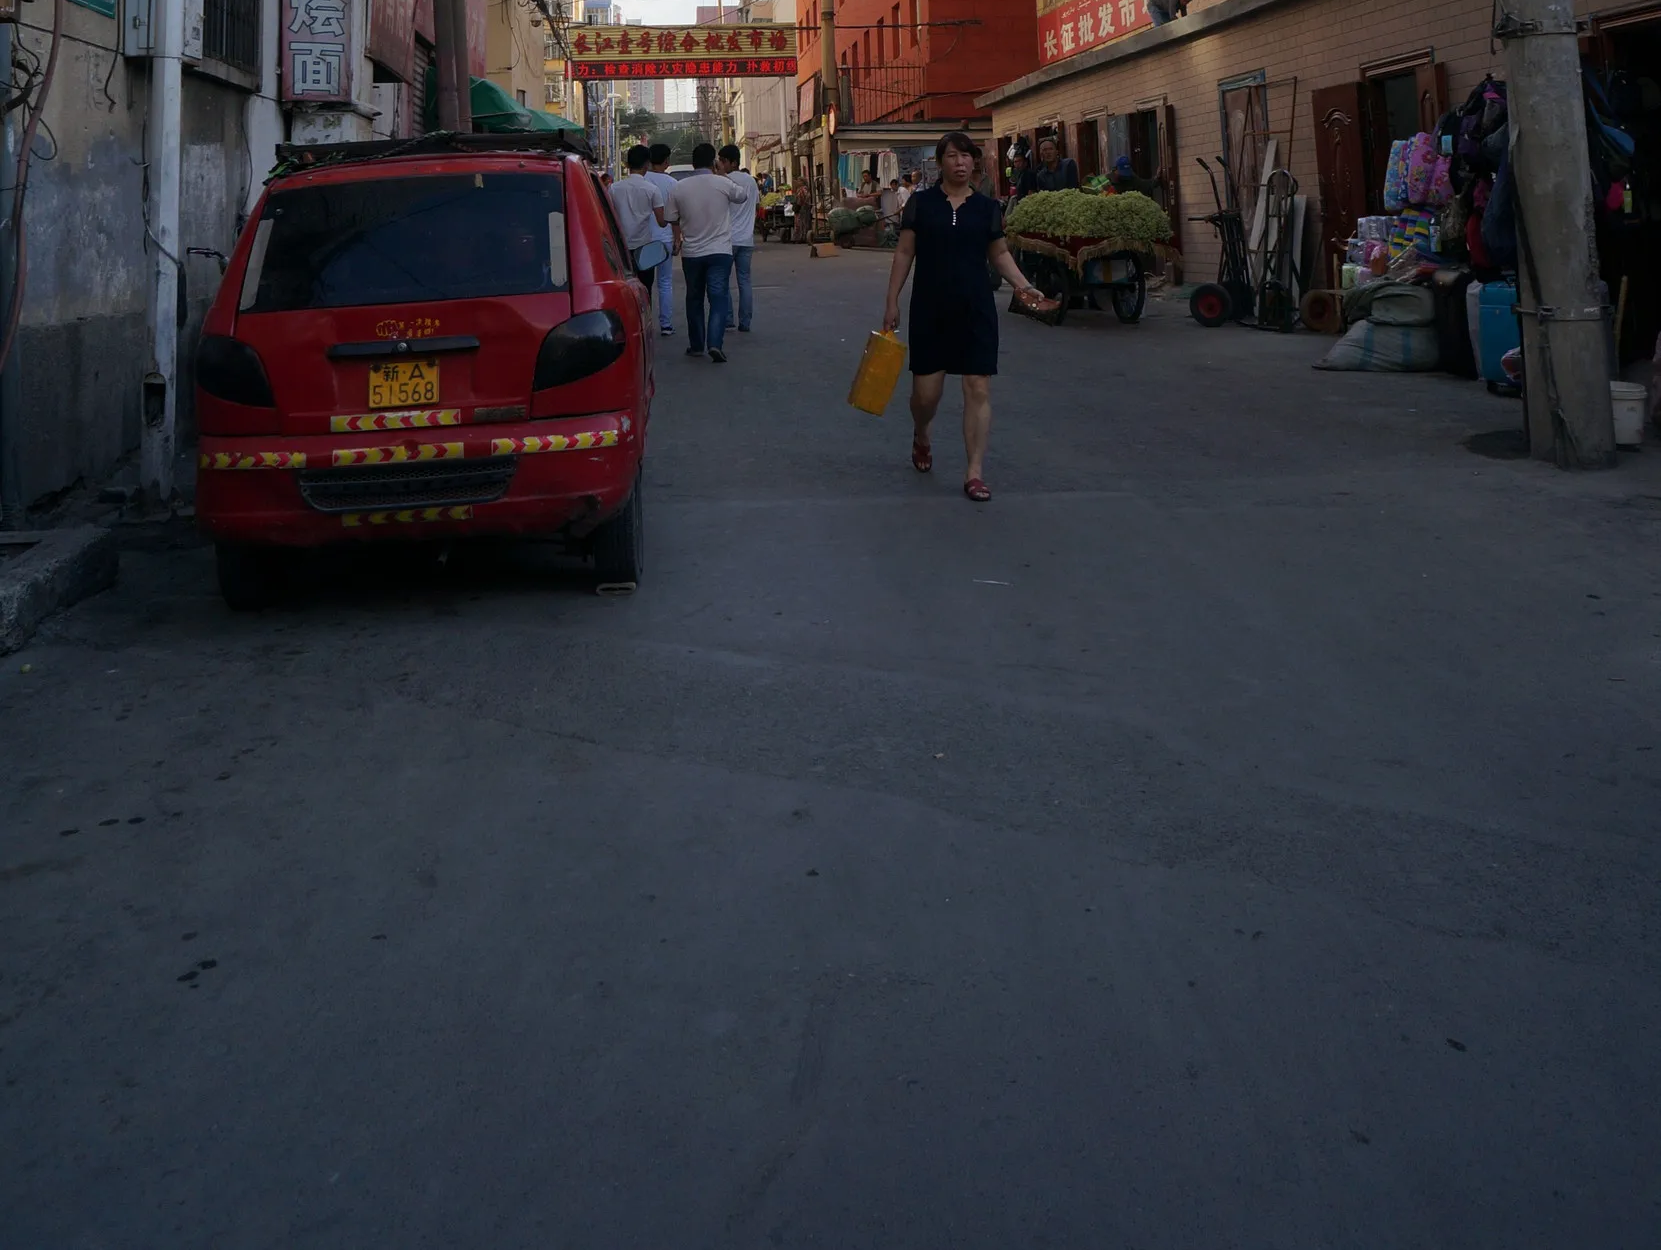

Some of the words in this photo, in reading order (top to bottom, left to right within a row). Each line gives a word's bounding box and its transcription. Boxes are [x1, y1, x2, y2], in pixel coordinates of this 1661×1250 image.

[572, 29, 788, 55] 长江壹号综合批发市场
[372, 381, 434, 405] 51568
